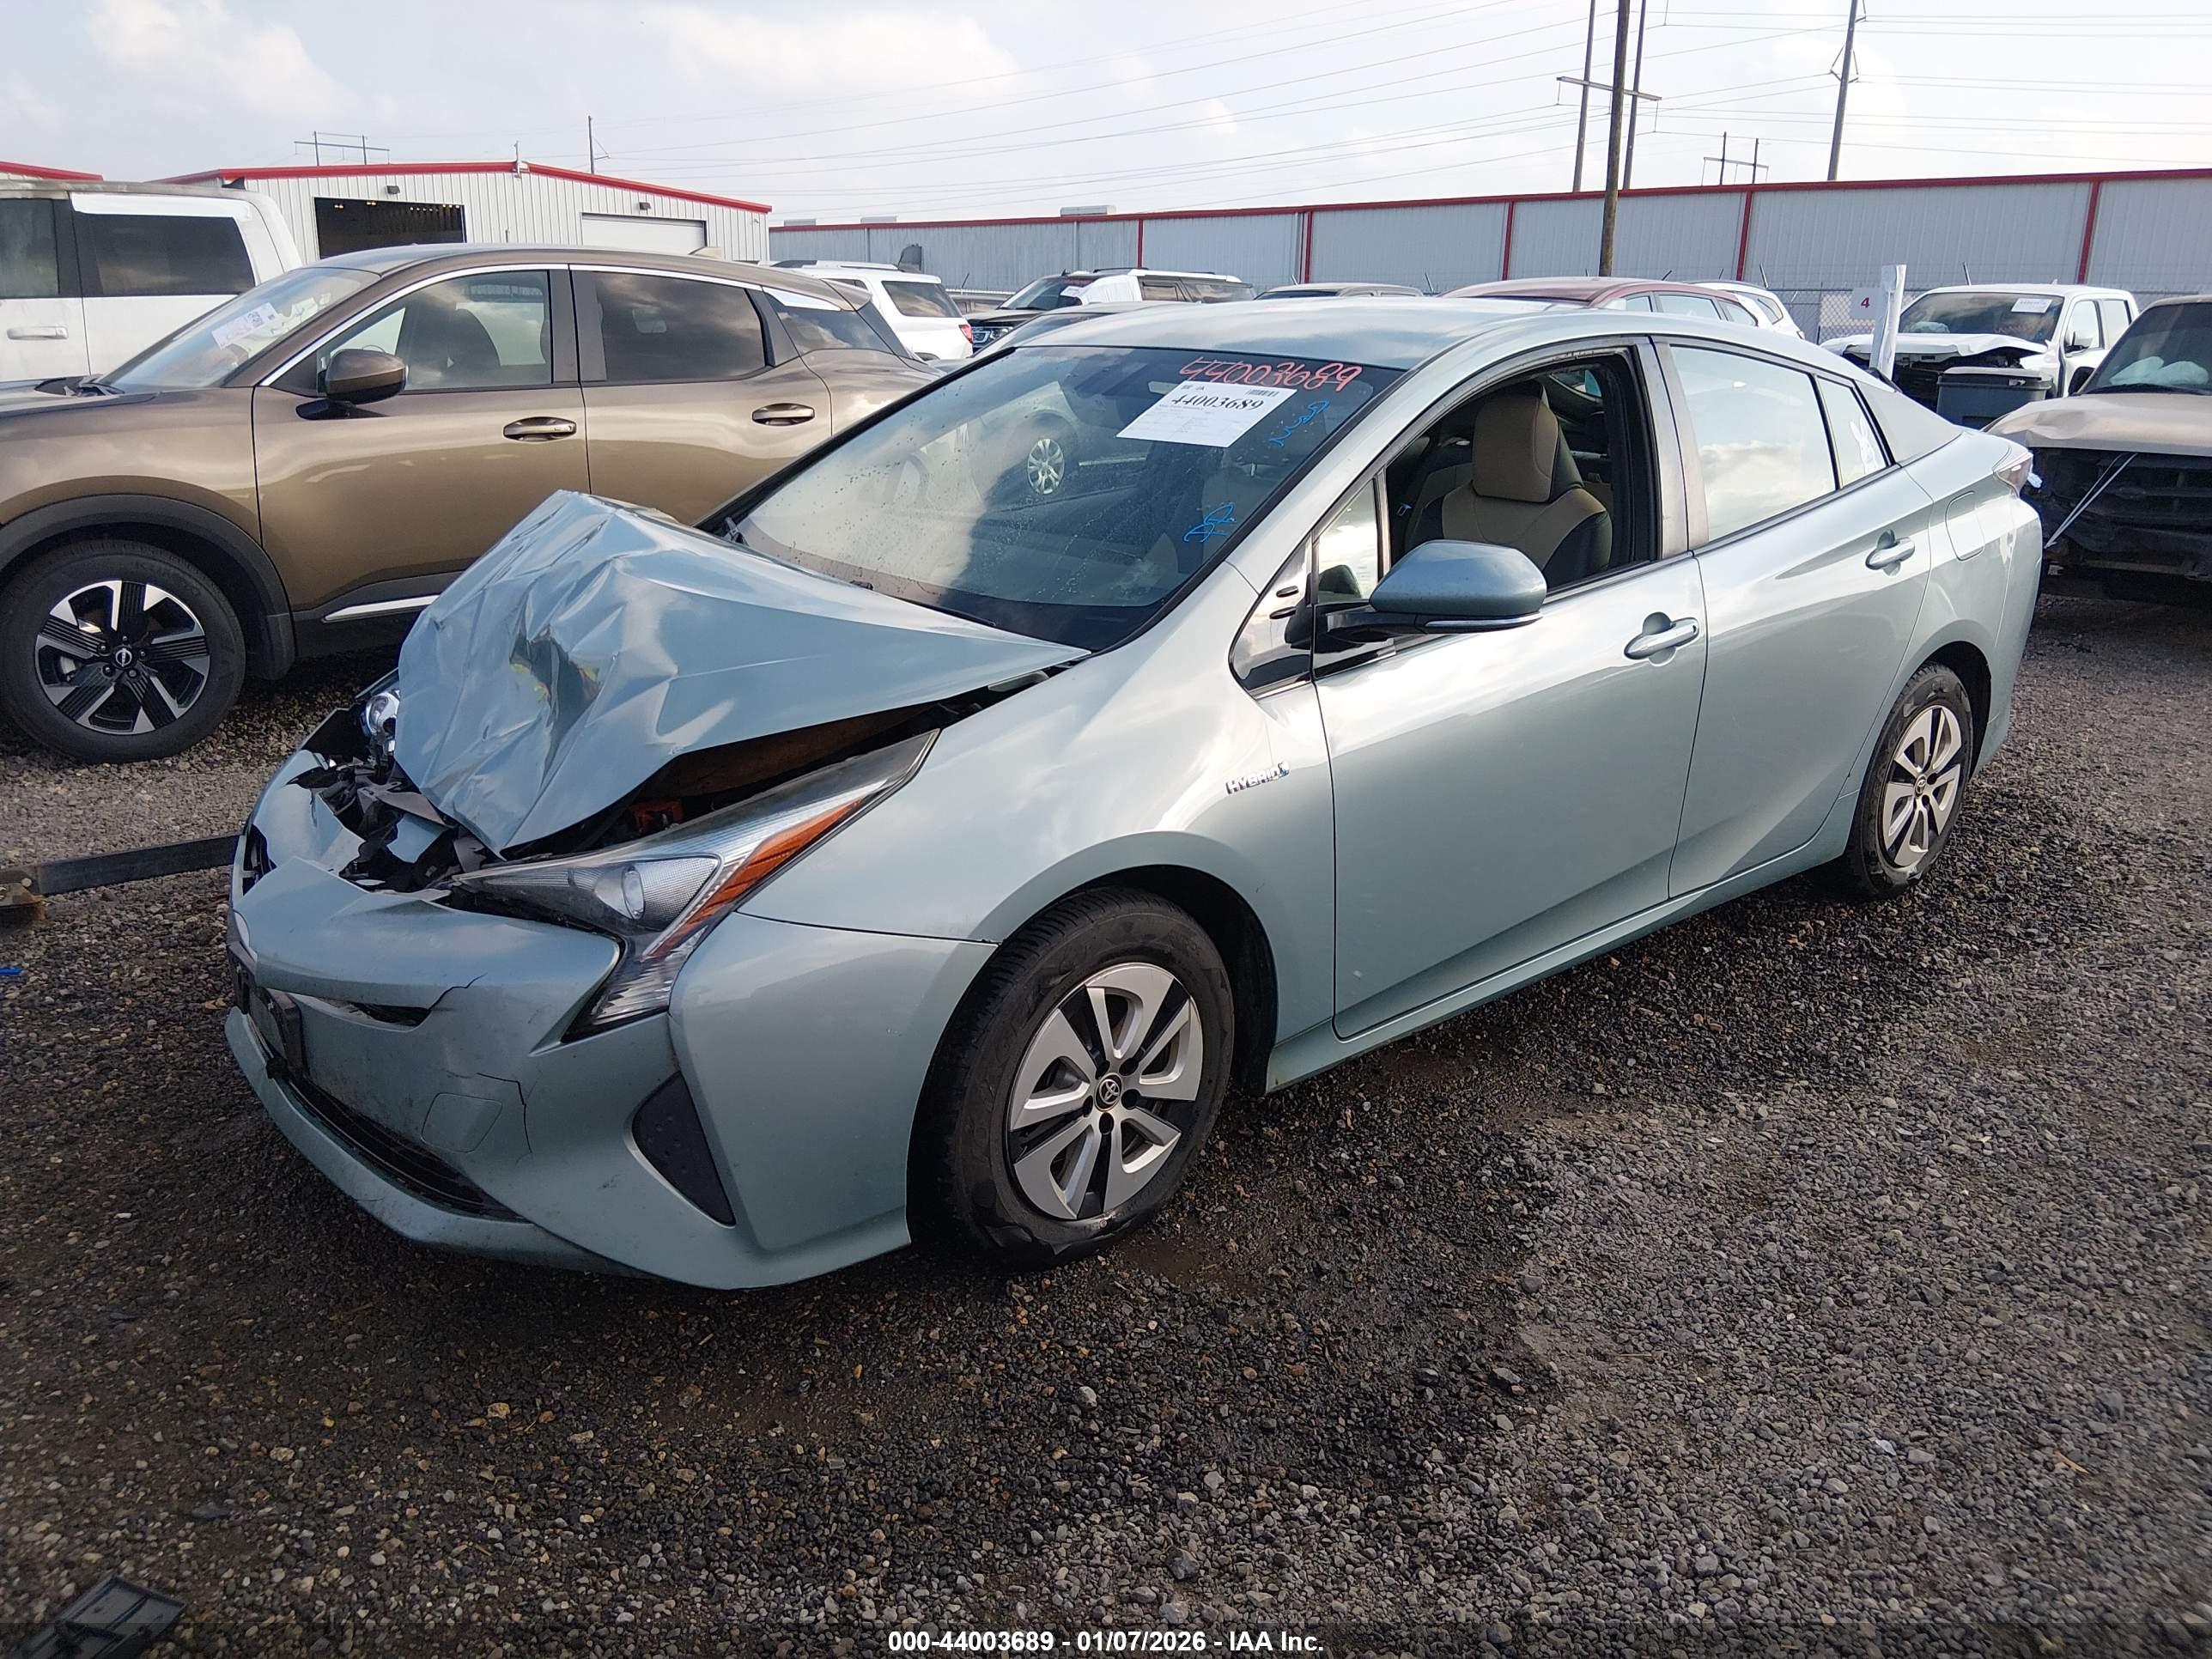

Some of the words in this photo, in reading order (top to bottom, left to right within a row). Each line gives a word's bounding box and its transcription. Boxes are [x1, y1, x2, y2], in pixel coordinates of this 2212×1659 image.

[1861, 297, 1870, 308] 4
[1179, 356, 1362, 392] 44003689
[1171, 394, 1264, 410] 44003689
